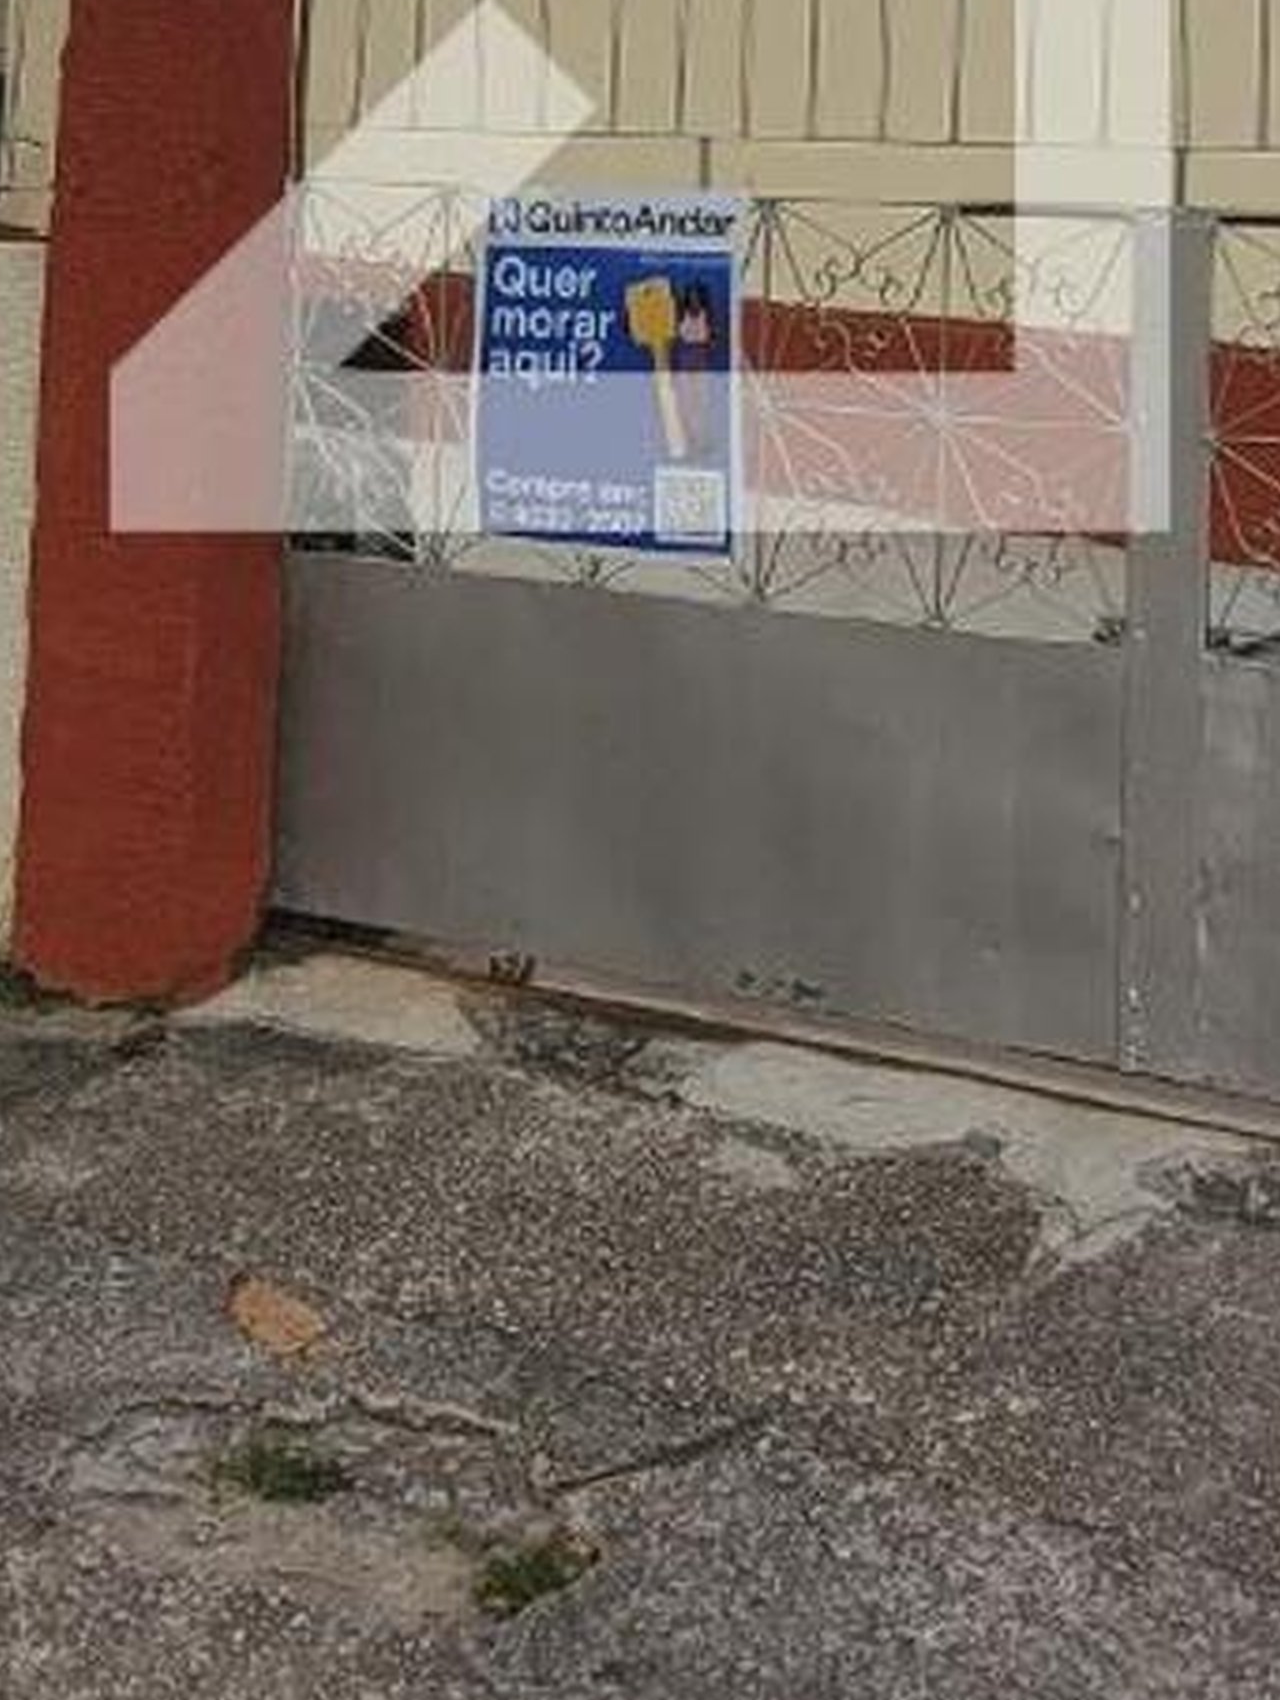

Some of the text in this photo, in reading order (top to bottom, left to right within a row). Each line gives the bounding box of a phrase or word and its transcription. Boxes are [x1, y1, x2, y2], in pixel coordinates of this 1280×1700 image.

[525, 200, 736, 237] QuintoAndar
[493, 256, 597, 299] Quer
[492, 308, 616, 339] morar
[488, 341, 604, 390] aqui?
